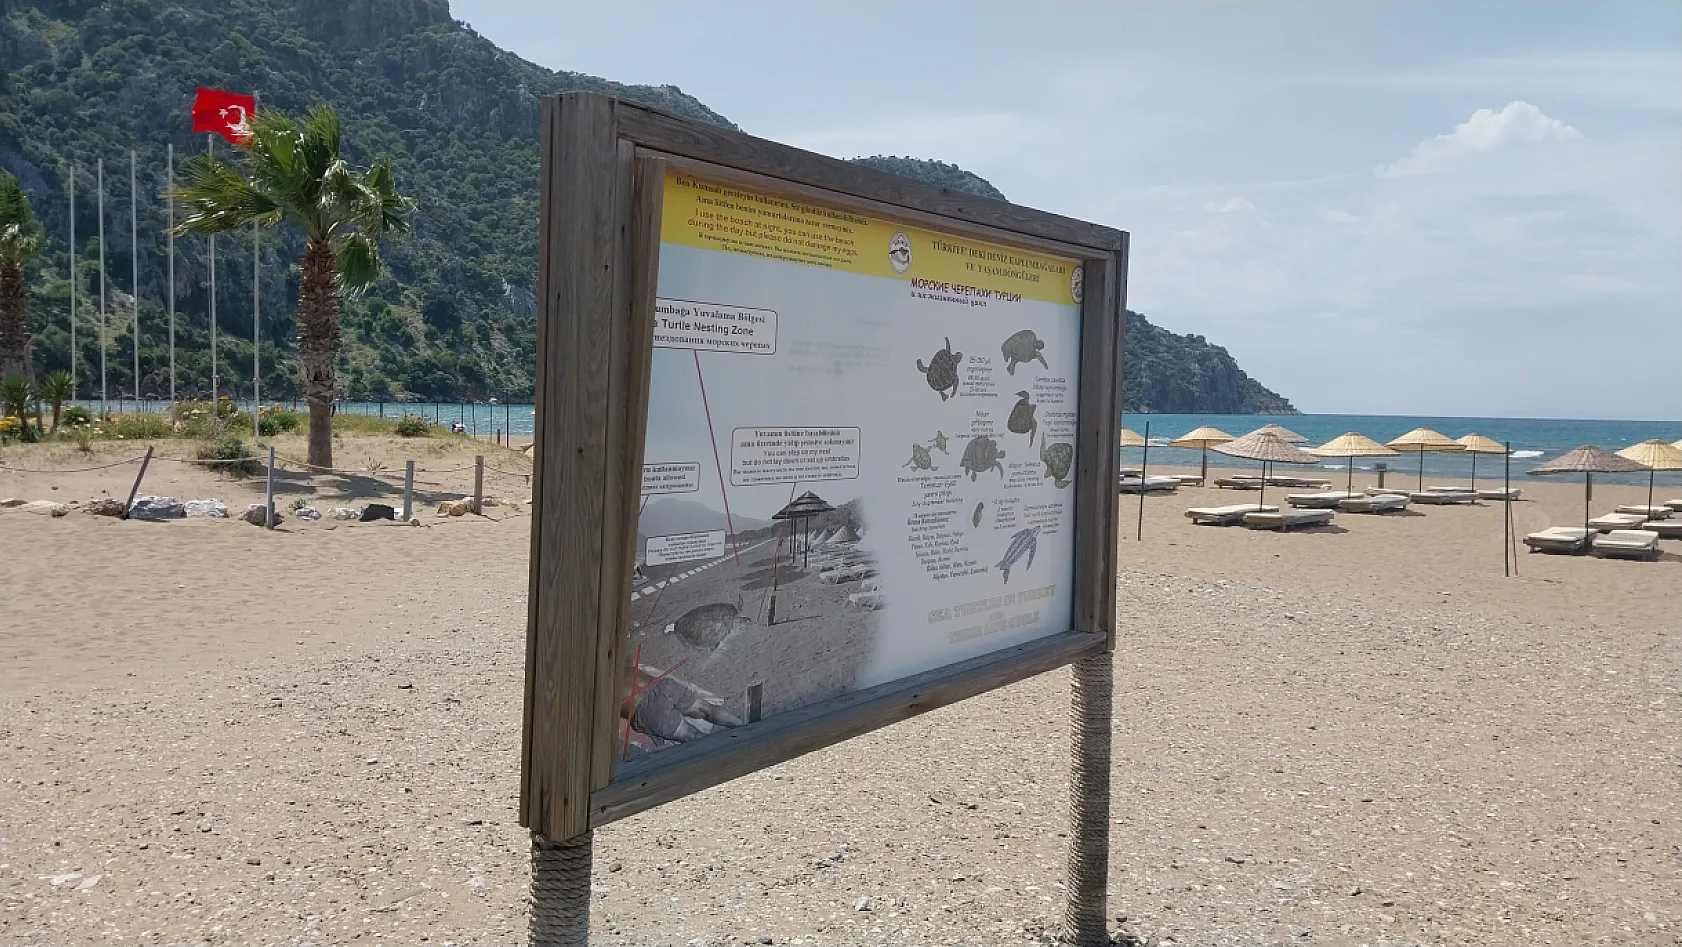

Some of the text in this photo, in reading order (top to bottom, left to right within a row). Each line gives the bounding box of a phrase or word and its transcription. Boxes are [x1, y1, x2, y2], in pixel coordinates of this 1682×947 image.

[687, 218, 714, 231] during
[716, 223, 729, 233] the
[730, 226, 744, 237] day
[783, 235, 792, 244] do
[700, 210, 714, 219] use
[716, 212, 729, 223] the
[730, 215, 753, 226] beach
[824, 234, 835, 243] the
[835, 236, 855, 248] beach
[911, 277, 1022, 303] МОРСКИЕ ЧЕРЕПАХИ ТУРЦИИ
[661, 318, 691, 331] Turtle
[693, 321, 729, 336] Nesting
[731, 325, 754, 336] Zone
[928, 607, 952, 624] SEA
[953, 596, 1002, 617] TURTLES
[1003, 592, 1016, 606] IN
